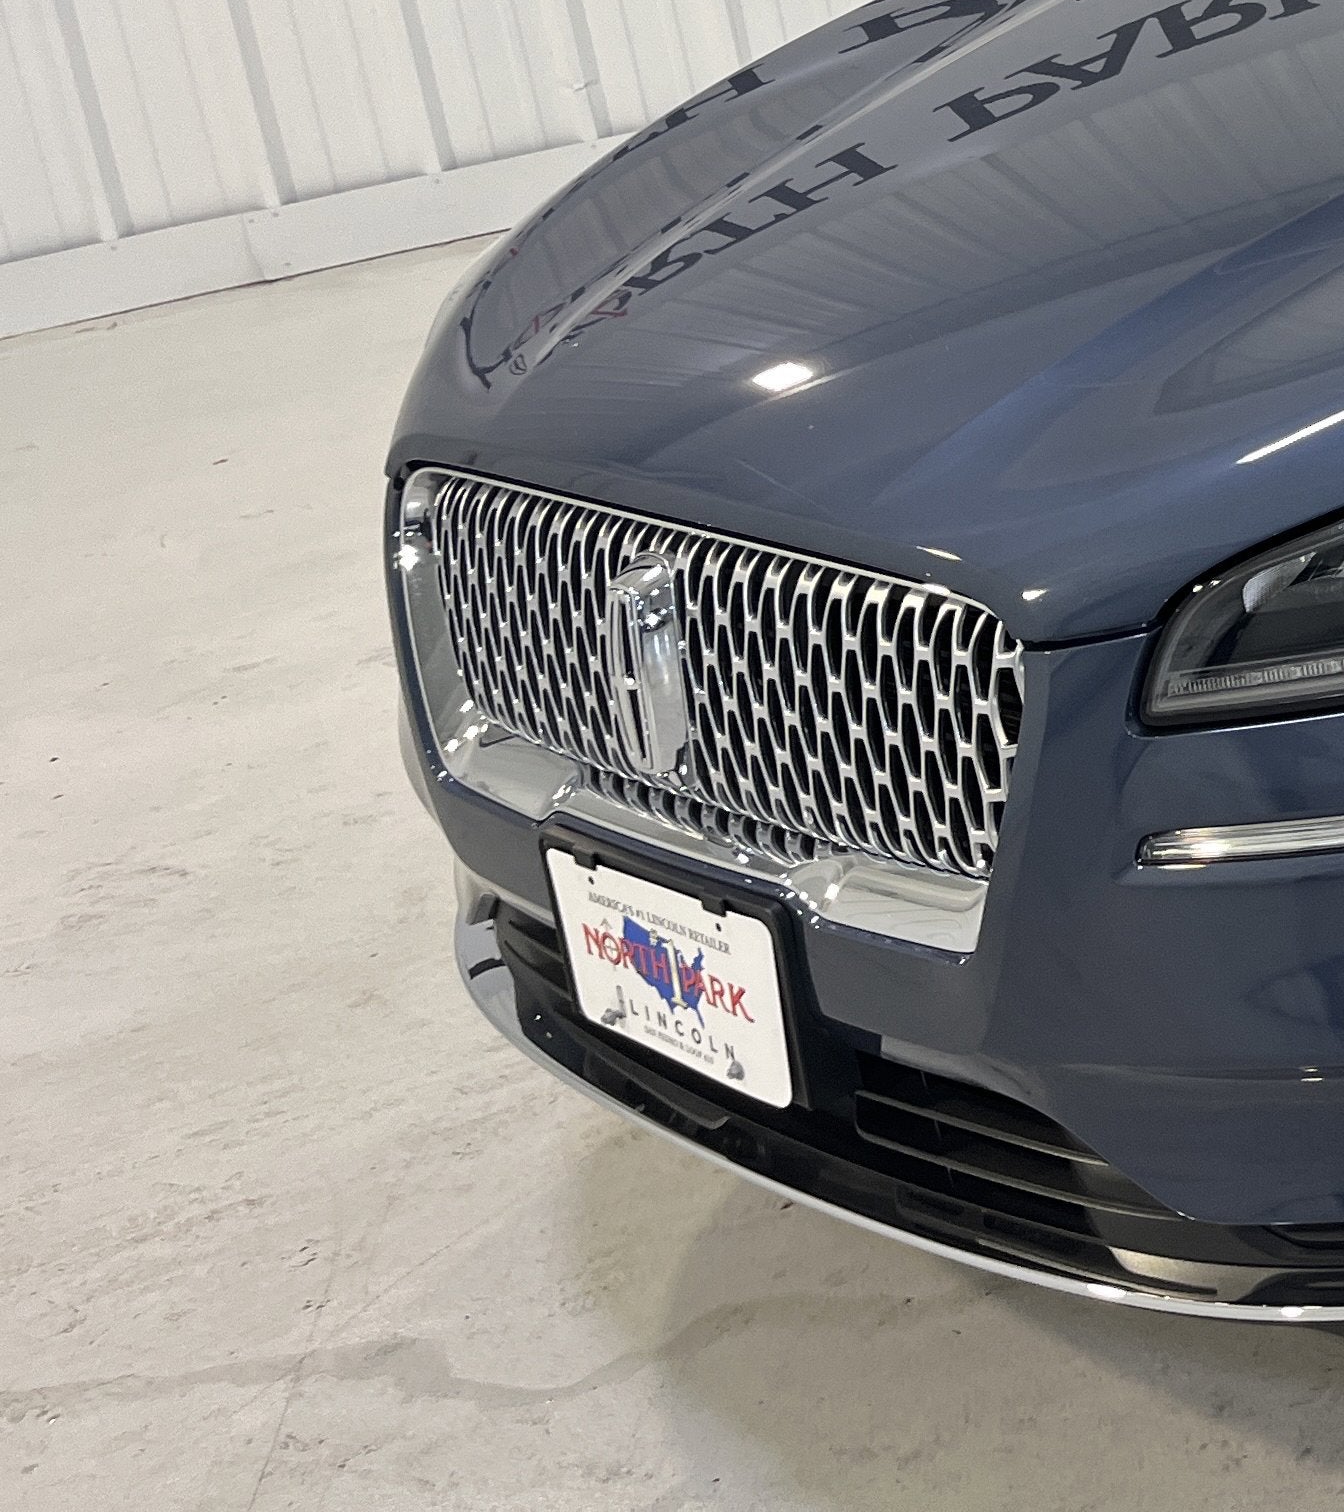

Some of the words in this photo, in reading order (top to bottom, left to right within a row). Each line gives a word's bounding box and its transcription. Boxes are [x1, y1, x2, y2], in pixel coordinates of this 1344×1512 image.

[646, 912, 687, 936] LINCOLN
[688, 928, 731, 955] RETAILER
[582, 923, 670, 984] NORTH
[680, 963, 755, 1023] PARK
[629, 999, 735, 1059] LINCOLN
